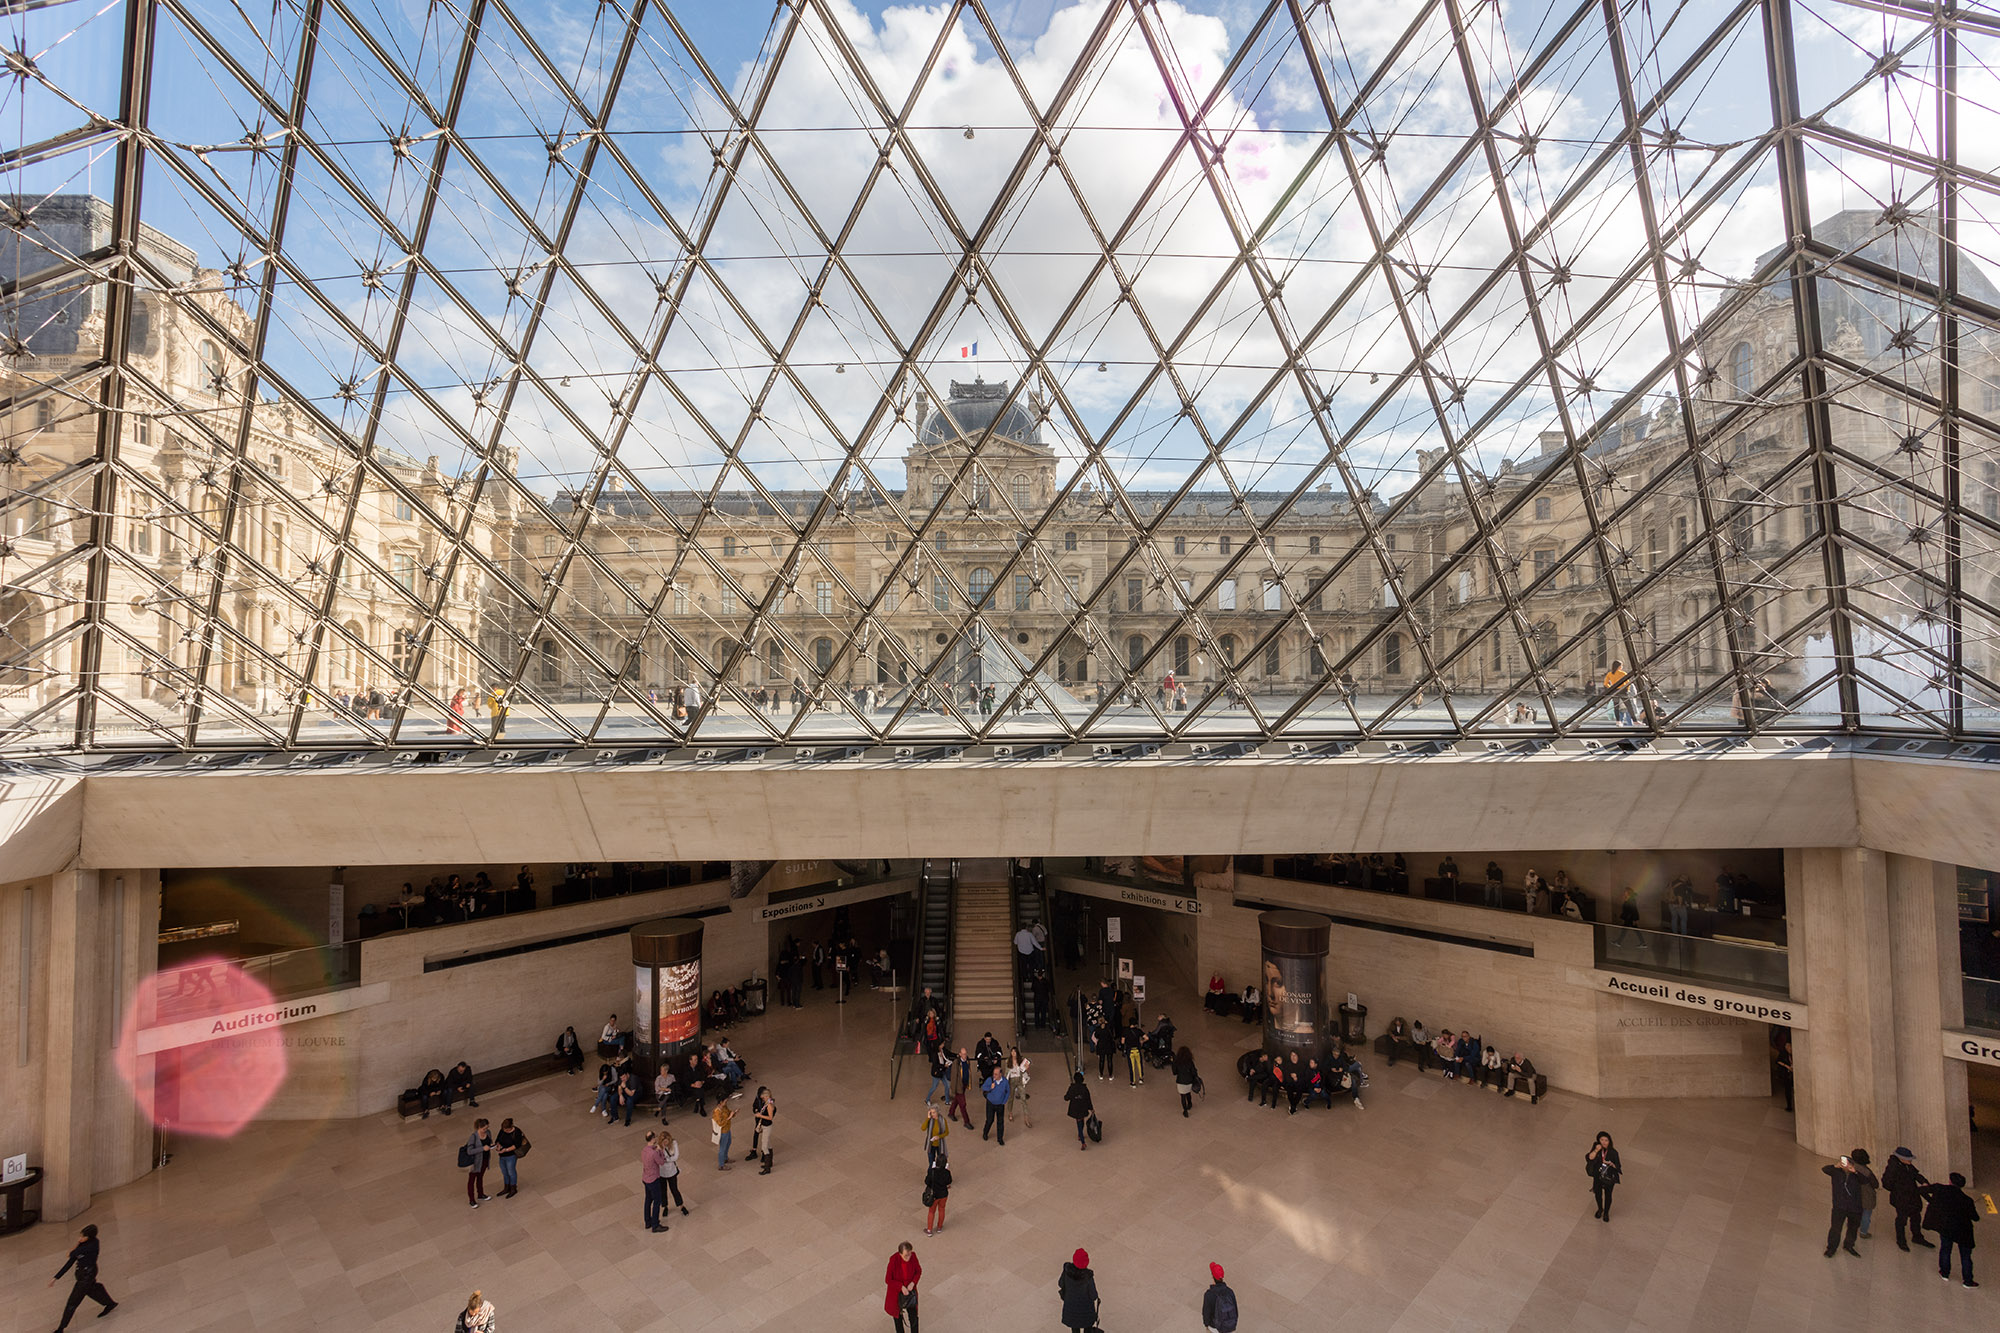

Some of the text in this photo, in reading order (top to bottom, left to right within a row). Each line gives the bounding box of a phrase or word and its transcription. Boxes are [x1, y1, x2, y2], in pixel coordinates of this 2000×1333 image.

[785, 861, 819, 874] SULLY
[1121, 890, 1167, 907] Exhibitions
[762, 902, 814, 919] Expositions
[1608, 977, 1792, 1022] Accueil des groupes
[211, 1004, 317, 1034] Auditorium
[1616, 1016, 1749, 1027] ACCUEIL DES GROUPES
[208, 1037, 346, 1049] DITORIUM DU LOUVRE
